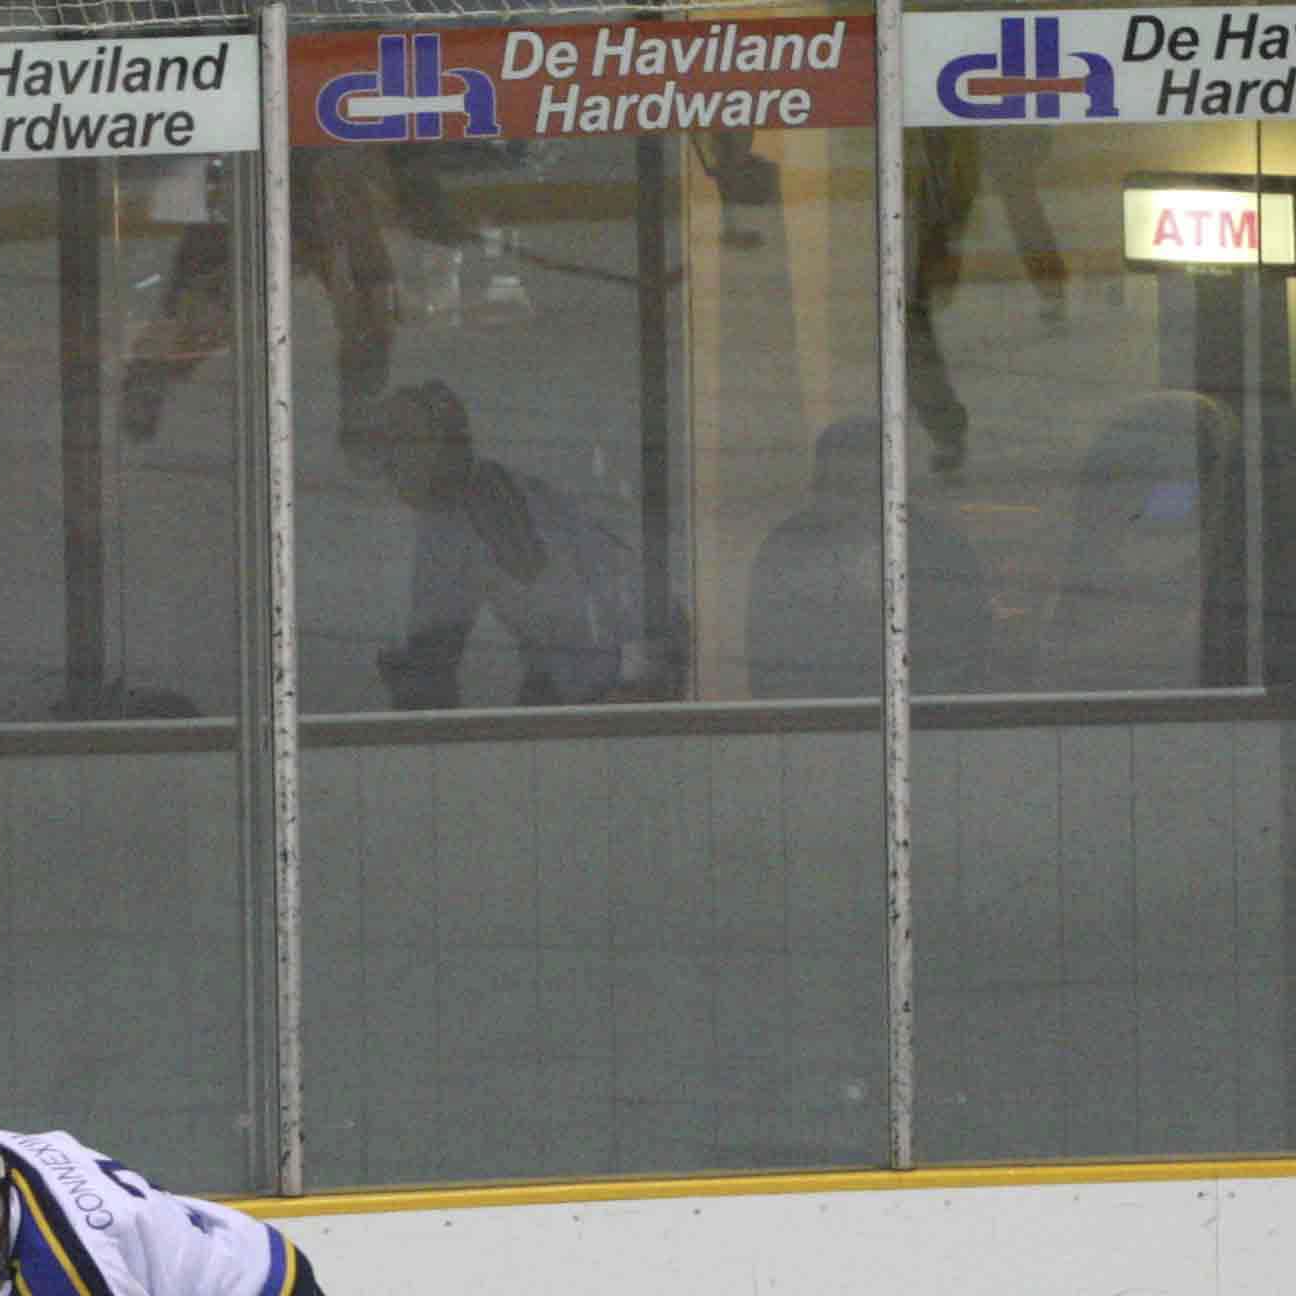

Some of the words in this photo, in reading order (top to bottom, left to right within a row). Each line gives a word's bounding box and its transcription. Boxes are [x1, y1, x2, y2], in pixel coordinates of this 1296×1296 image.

[501, 31, 580, 81] De
[591, 21, 847, 79] Haviland
[1122, 14, 1200, 63] De
[535, 81, 813, 134] Hardware
[1151, 207, 1260, 250] ATM
